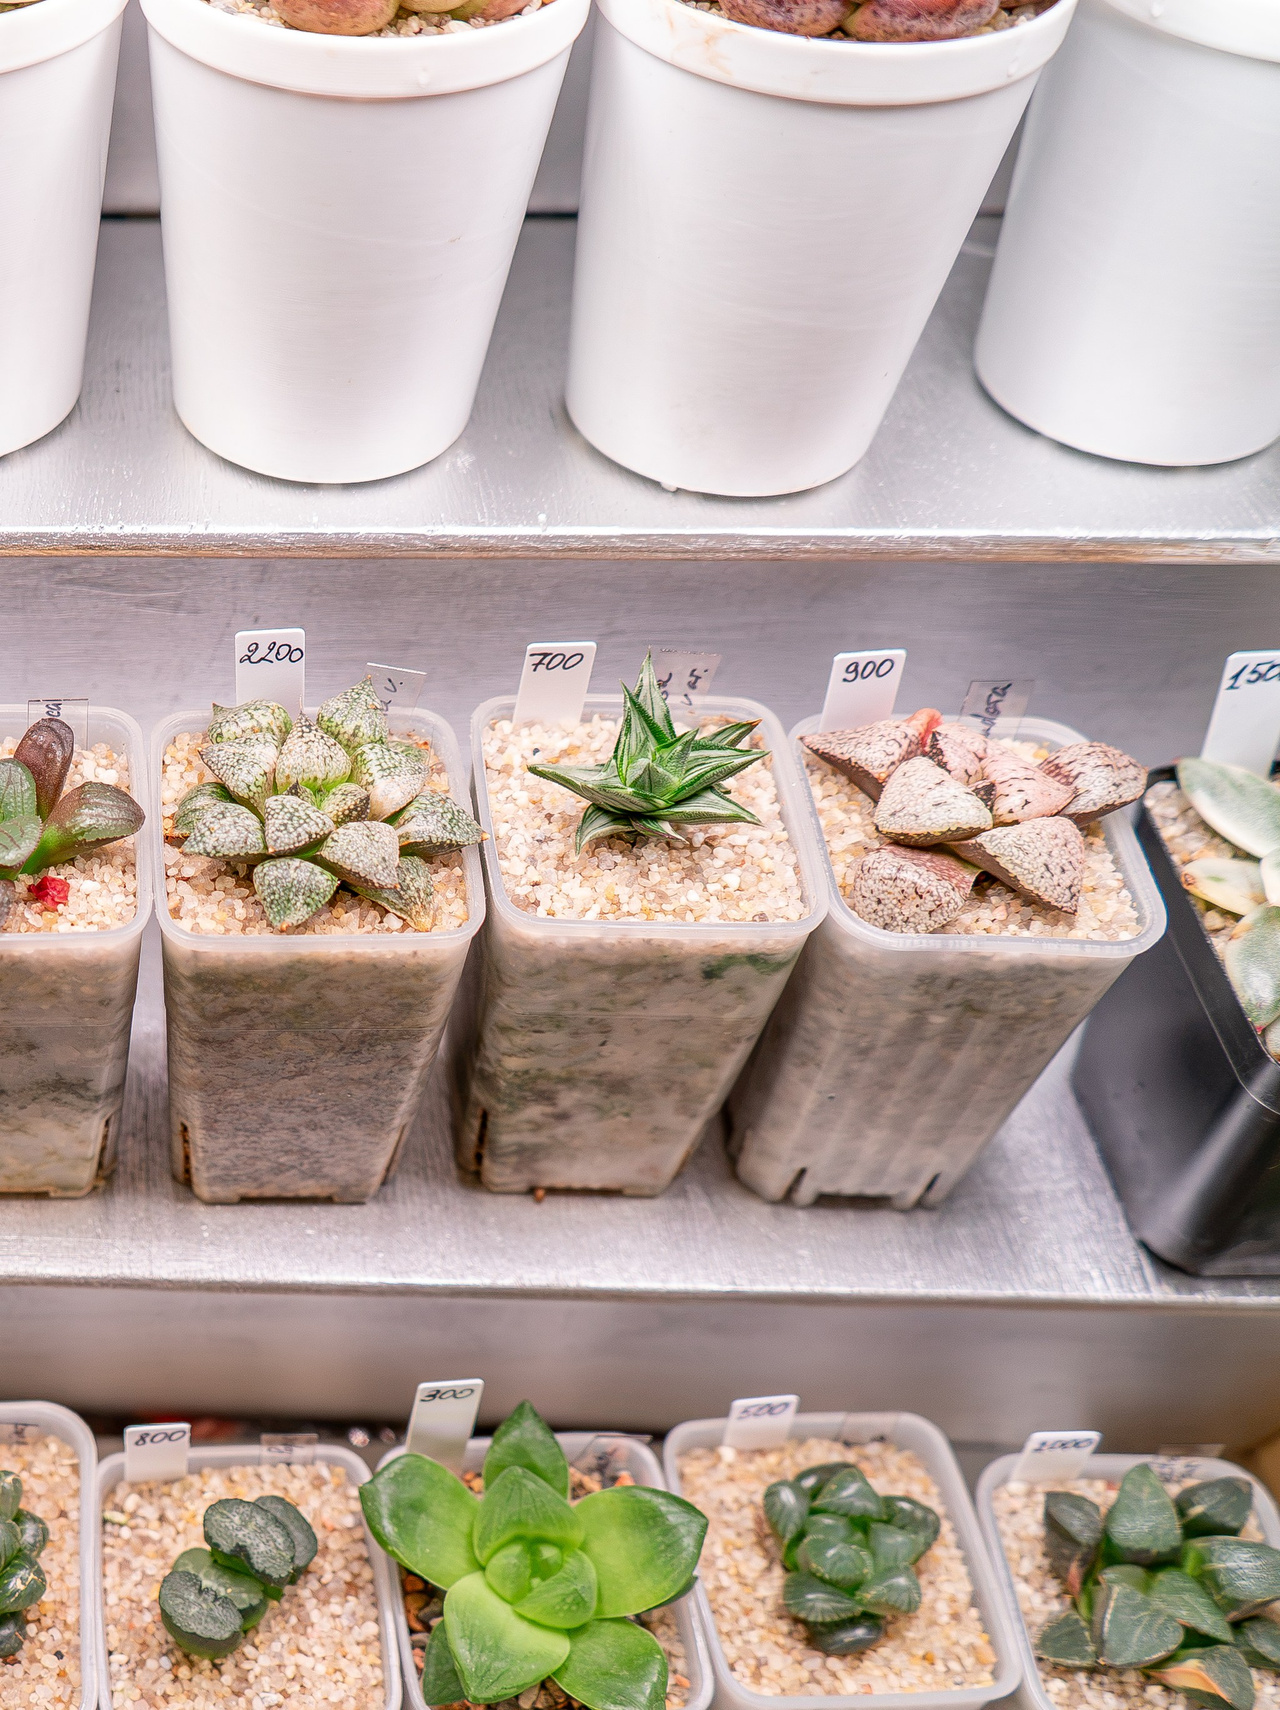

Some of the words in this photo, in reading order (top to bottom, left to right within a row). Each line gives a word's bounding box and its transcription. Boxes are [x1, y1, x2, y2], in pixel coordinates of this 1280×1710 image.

[239, 640, 304, 664] 2200
[529, 652, 584, 672] 700
[842, 658, 895, 683] 900
[1224, 659, 1280, 691] 150
[419, 1388, 475, 1403] 300
[134, 1430, 187, 1447] 800
